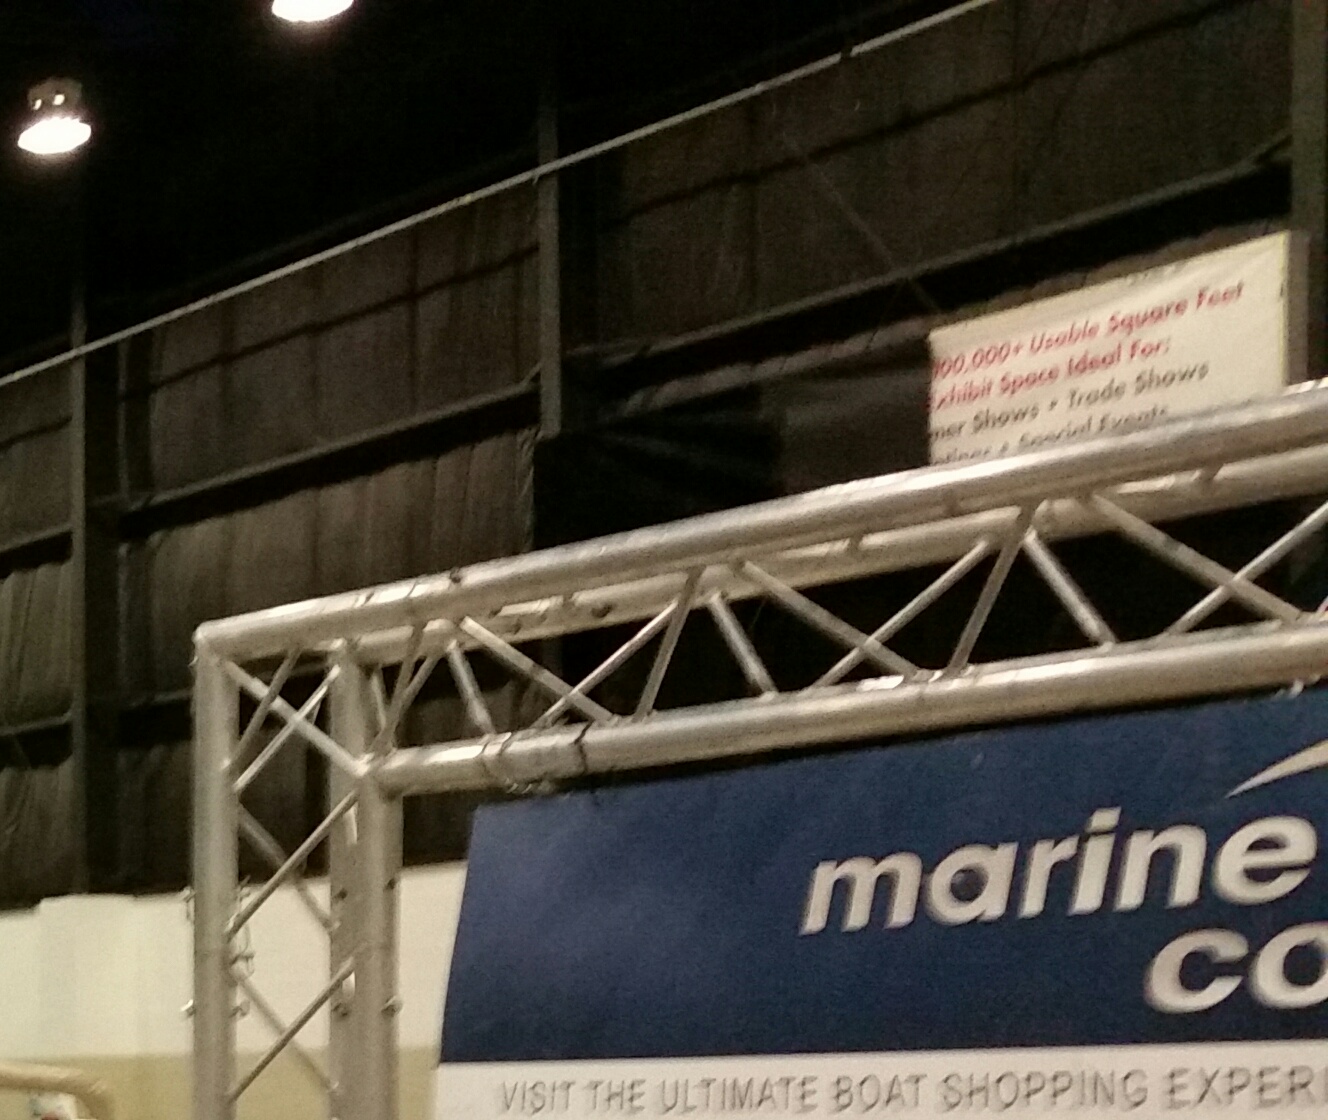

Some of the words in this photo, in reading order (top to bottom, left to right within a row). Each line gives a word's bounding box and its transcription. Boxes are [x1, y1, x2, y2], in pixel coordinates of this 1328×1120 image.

[1028, 320, 1100, 354] Usable
[1106, 301, 1189, 336] Square
[999, 367, 1061, 397] Space
[1135, 359, 1210, 395] Shows
[798, 806, 1320, 936] marine
[1145, 921, 1328, 1014] co
[499, 1078, 576, 1115] VISIT
[584, 1077, 646, 1115] THE
[656, 1074, 819, 1114] ULTIMATE
[831, 1072, 928, 1113] BOAT
[938, 1067, 1150, 1113] SHOPPING
